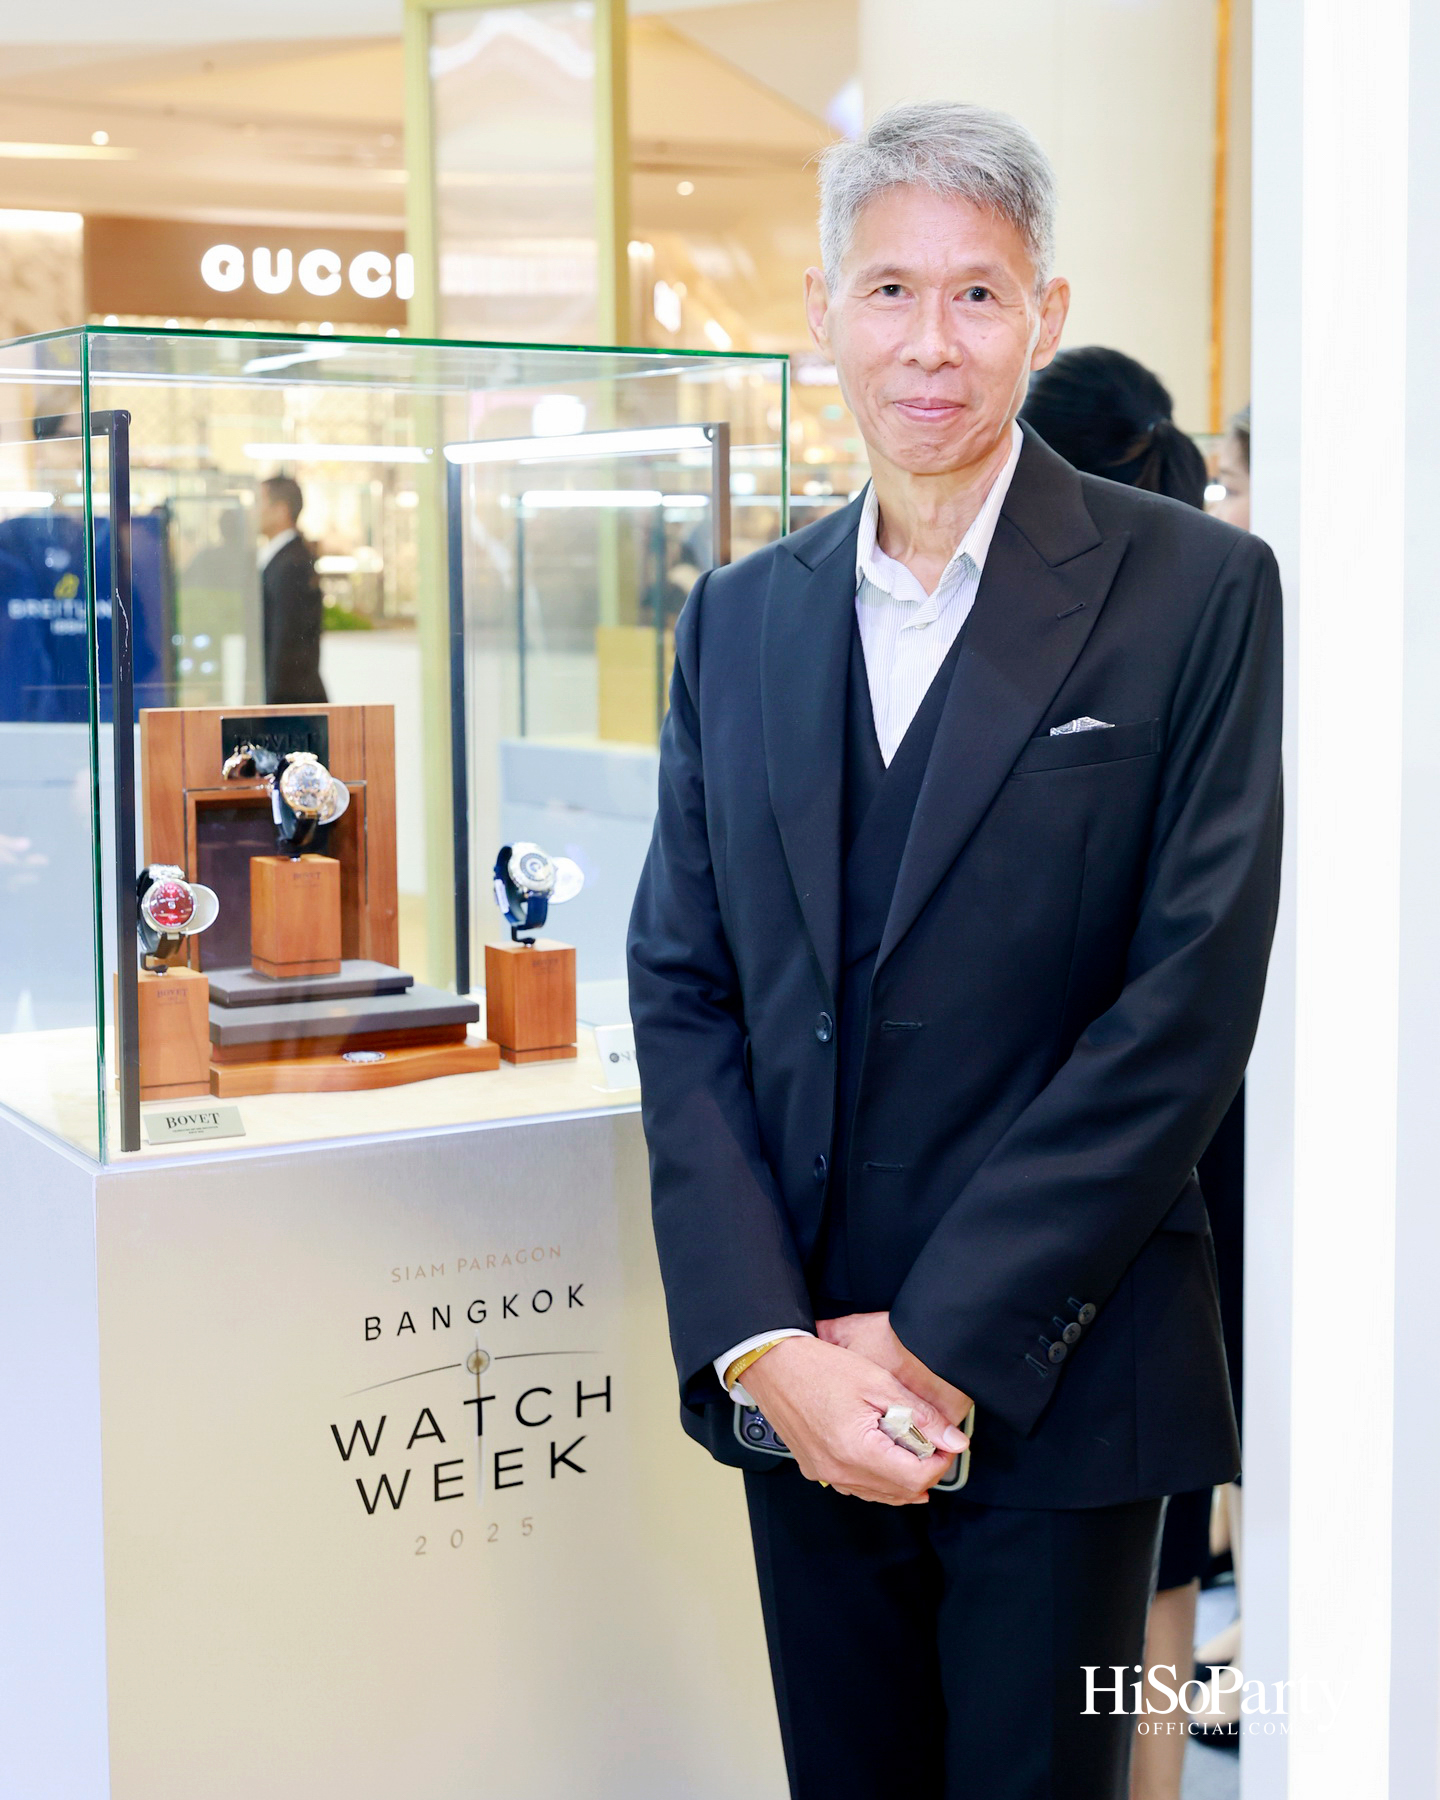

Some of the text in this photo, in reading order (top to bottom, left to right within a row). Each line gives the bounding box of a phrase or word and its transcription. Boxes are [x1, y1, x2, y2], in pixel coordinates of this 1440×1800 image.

[201, 244, 414, 300] GUCCI
[165, 1112, 220, 1129] BOVET
[391, 1245, 561, 1283] SIAM PARAGON
[365, 1283, 584, 1341] BANGKOK
[330, 1375, 611, 1461] WATCH
[355, 1435, 587, 1515] WEEK
[414, 1517, 533, 1556] 2025
